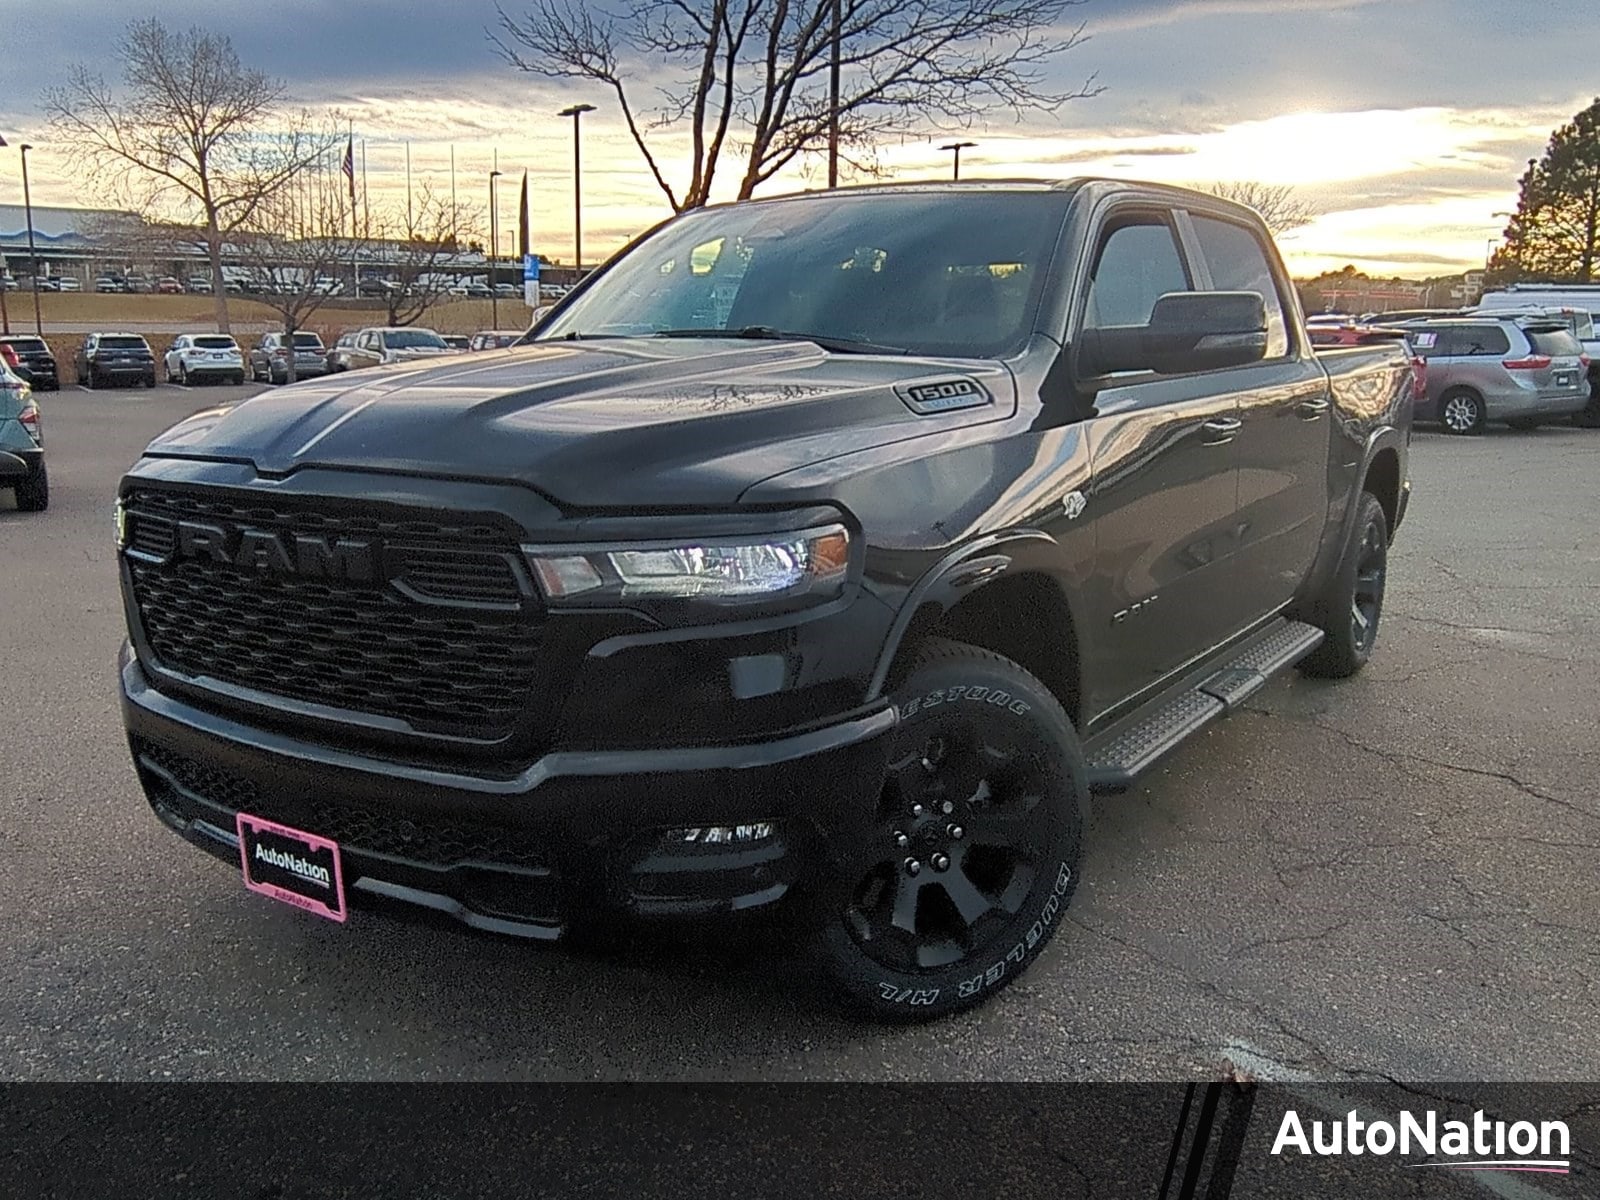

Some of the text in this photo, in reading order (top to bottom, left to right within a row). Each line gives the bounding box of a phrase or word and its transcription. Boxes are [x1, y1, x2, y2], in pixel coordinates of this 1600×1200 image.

[911, 382, 972, 401] 1500
[176, 520, 386, 582] RAM
[256, 843, 330, 882] AutoNation
[878, 862, 1072, 1006] DUELER H/L
